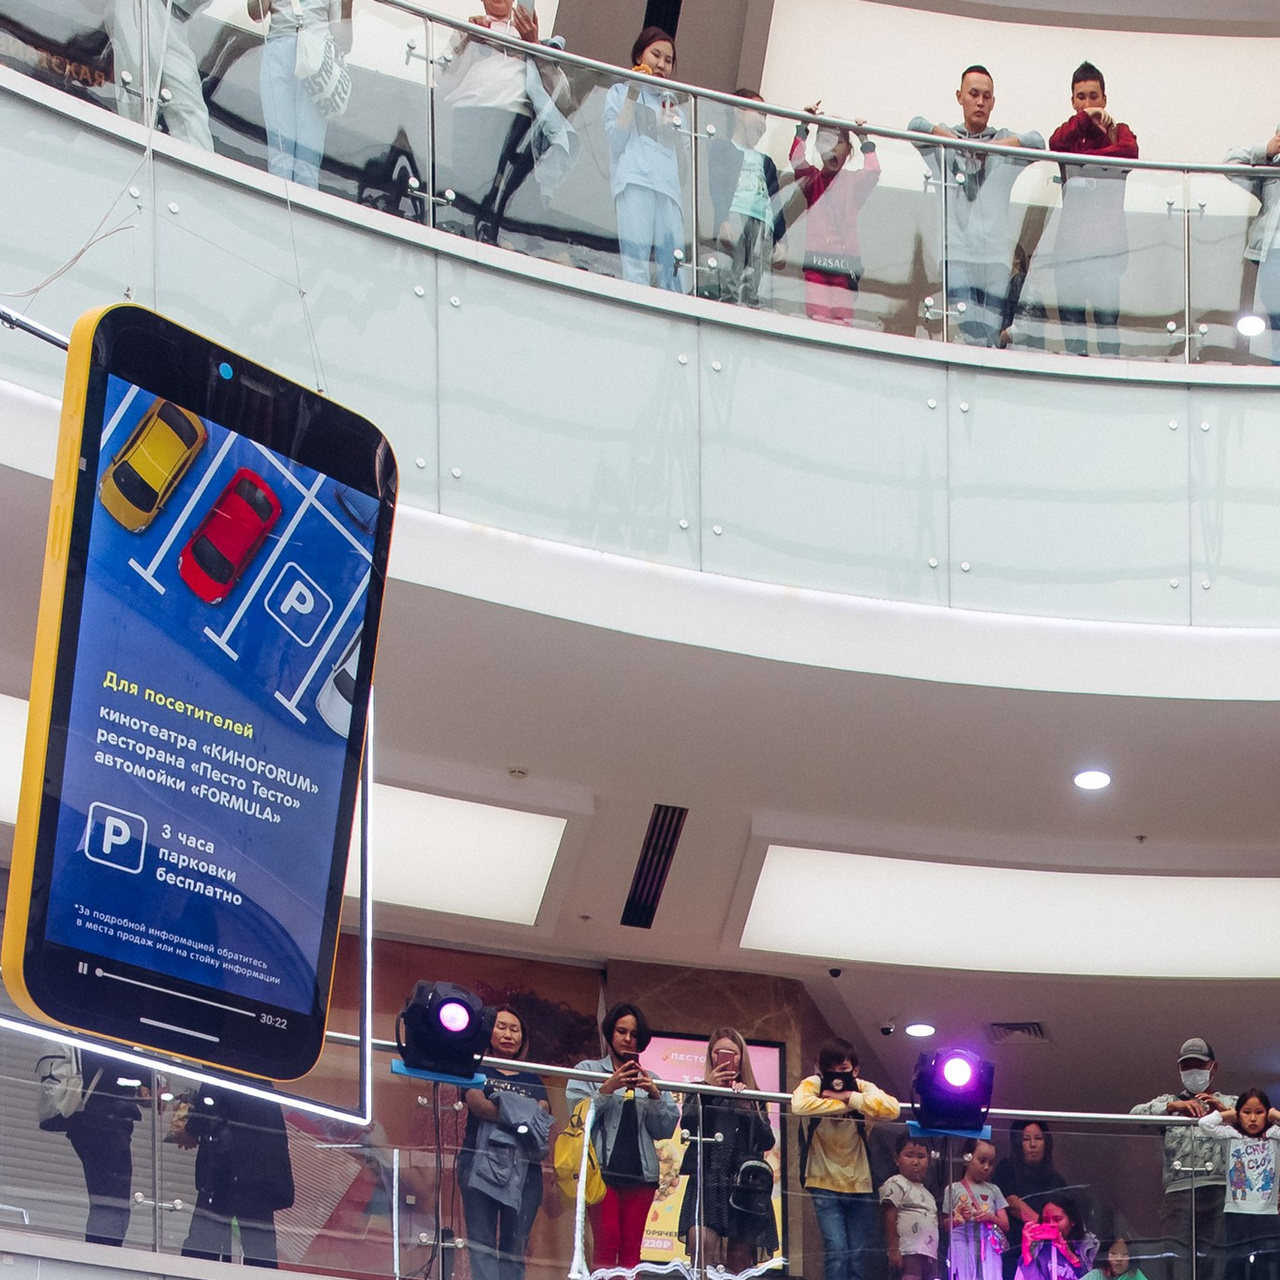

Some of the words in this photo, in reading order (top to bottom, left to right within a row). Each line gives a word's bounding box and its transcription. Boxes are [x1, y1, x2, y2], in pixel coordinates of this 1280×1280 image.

[102, 670, 139, 696] Для
[144, 688, 254, 739] посетителей
[97, 728, 185, 769] ресторана
[191, 760, 247, 791] «Песто
[251, 780, 301, 809] Тесто»
[99, 706, 197, 751] кинотеатра
[202, 744, 319, 794] «КИНОFORUM»
[94, 750, 186, 792] автомойки
[191, 784, 281, 824] «FORMULA»
[102, 816, 131, 854] P
[160, 824, 172, 840] 3
[177, 831, 216, 854] часа
[155, 867, 243, 906] бесплатно
[158, 848, 237, 883] парковки
[85, 921, 114, 936] места
[117, 930, 154, 947] продаж
[156, 940, 174, 953] или
[176, 946, 187, 957] на
[190, 951, 220, 969] стойку
[222, 961, 281, 985] информации
[93, 910, 147, 932] подробной
[148, 927, 215, 953] информацией
[217, 947, 268, 969] обратитесь
[260, 1013, 288, 1029] 30:22
[645, 1229, 678, 1237] ОРЯЧЕ
